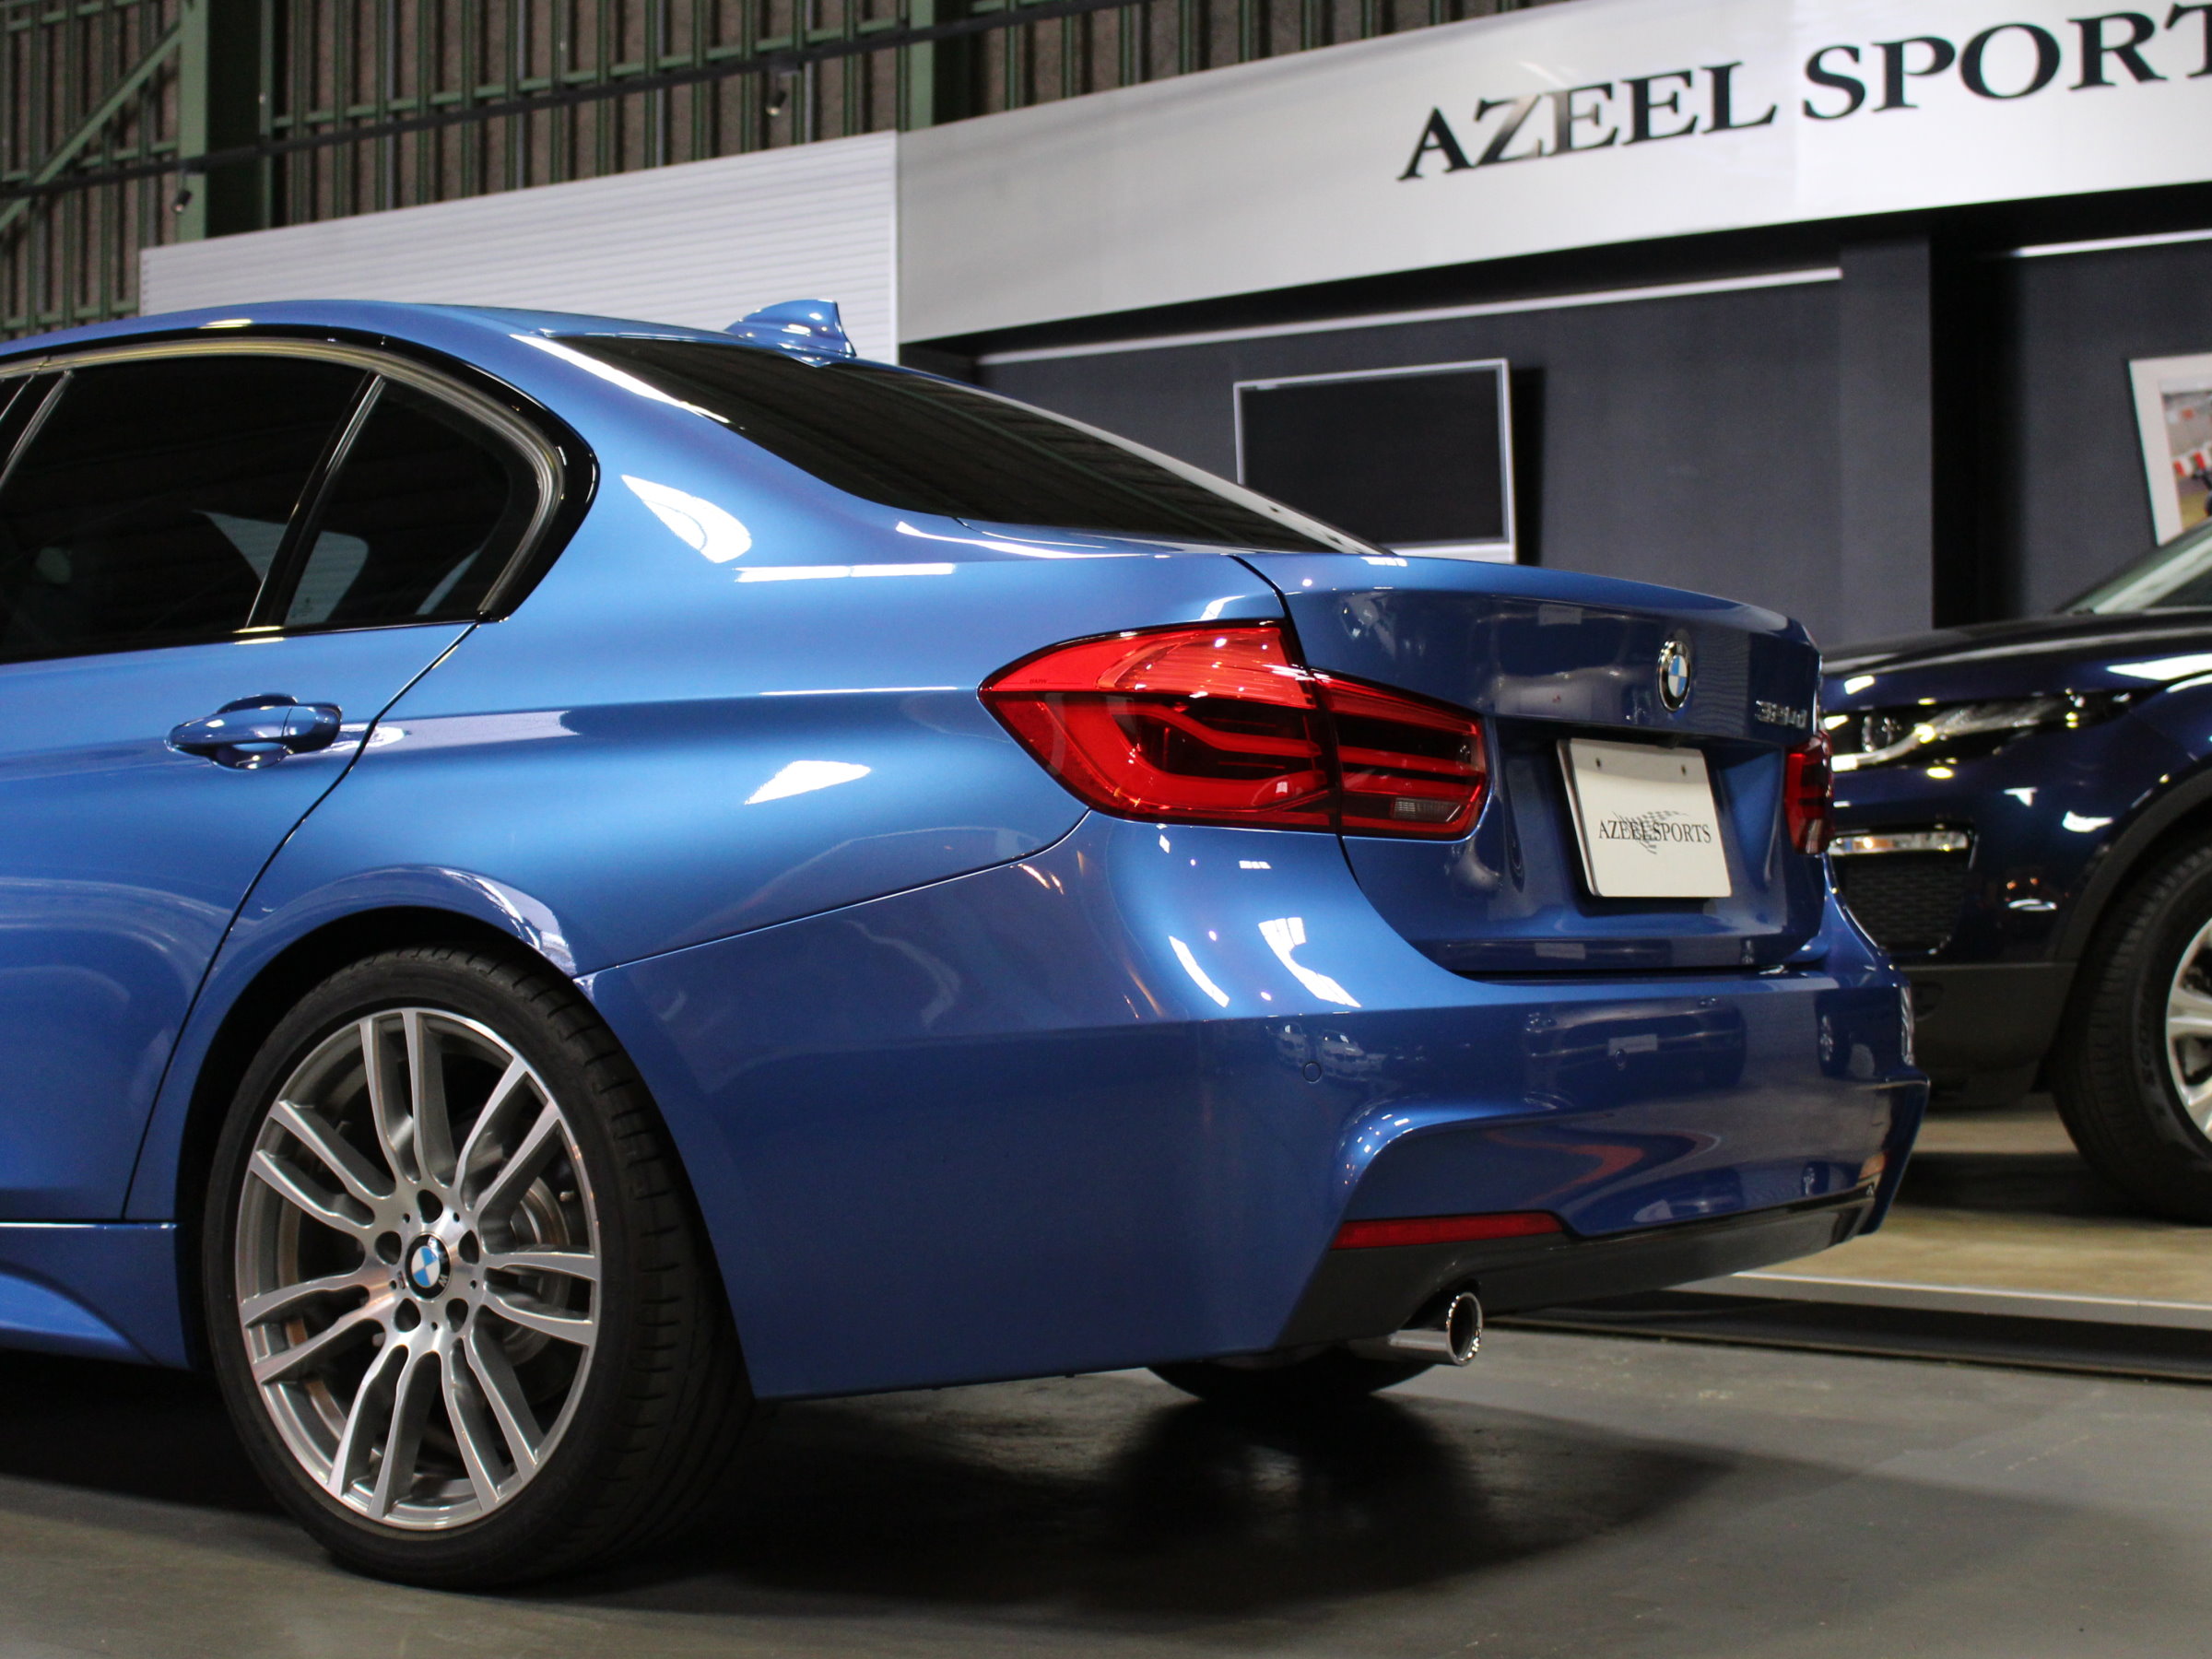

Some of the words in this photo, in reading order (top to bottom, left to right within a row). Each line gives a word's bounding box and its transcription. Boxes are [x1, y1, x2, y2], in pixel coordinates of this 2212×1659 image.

[1396, 61, 1778, 182] AZEEL
[1598, 818, 1658, 841] AZEEL
[1653, 820, 1712, 844] SPORTS
